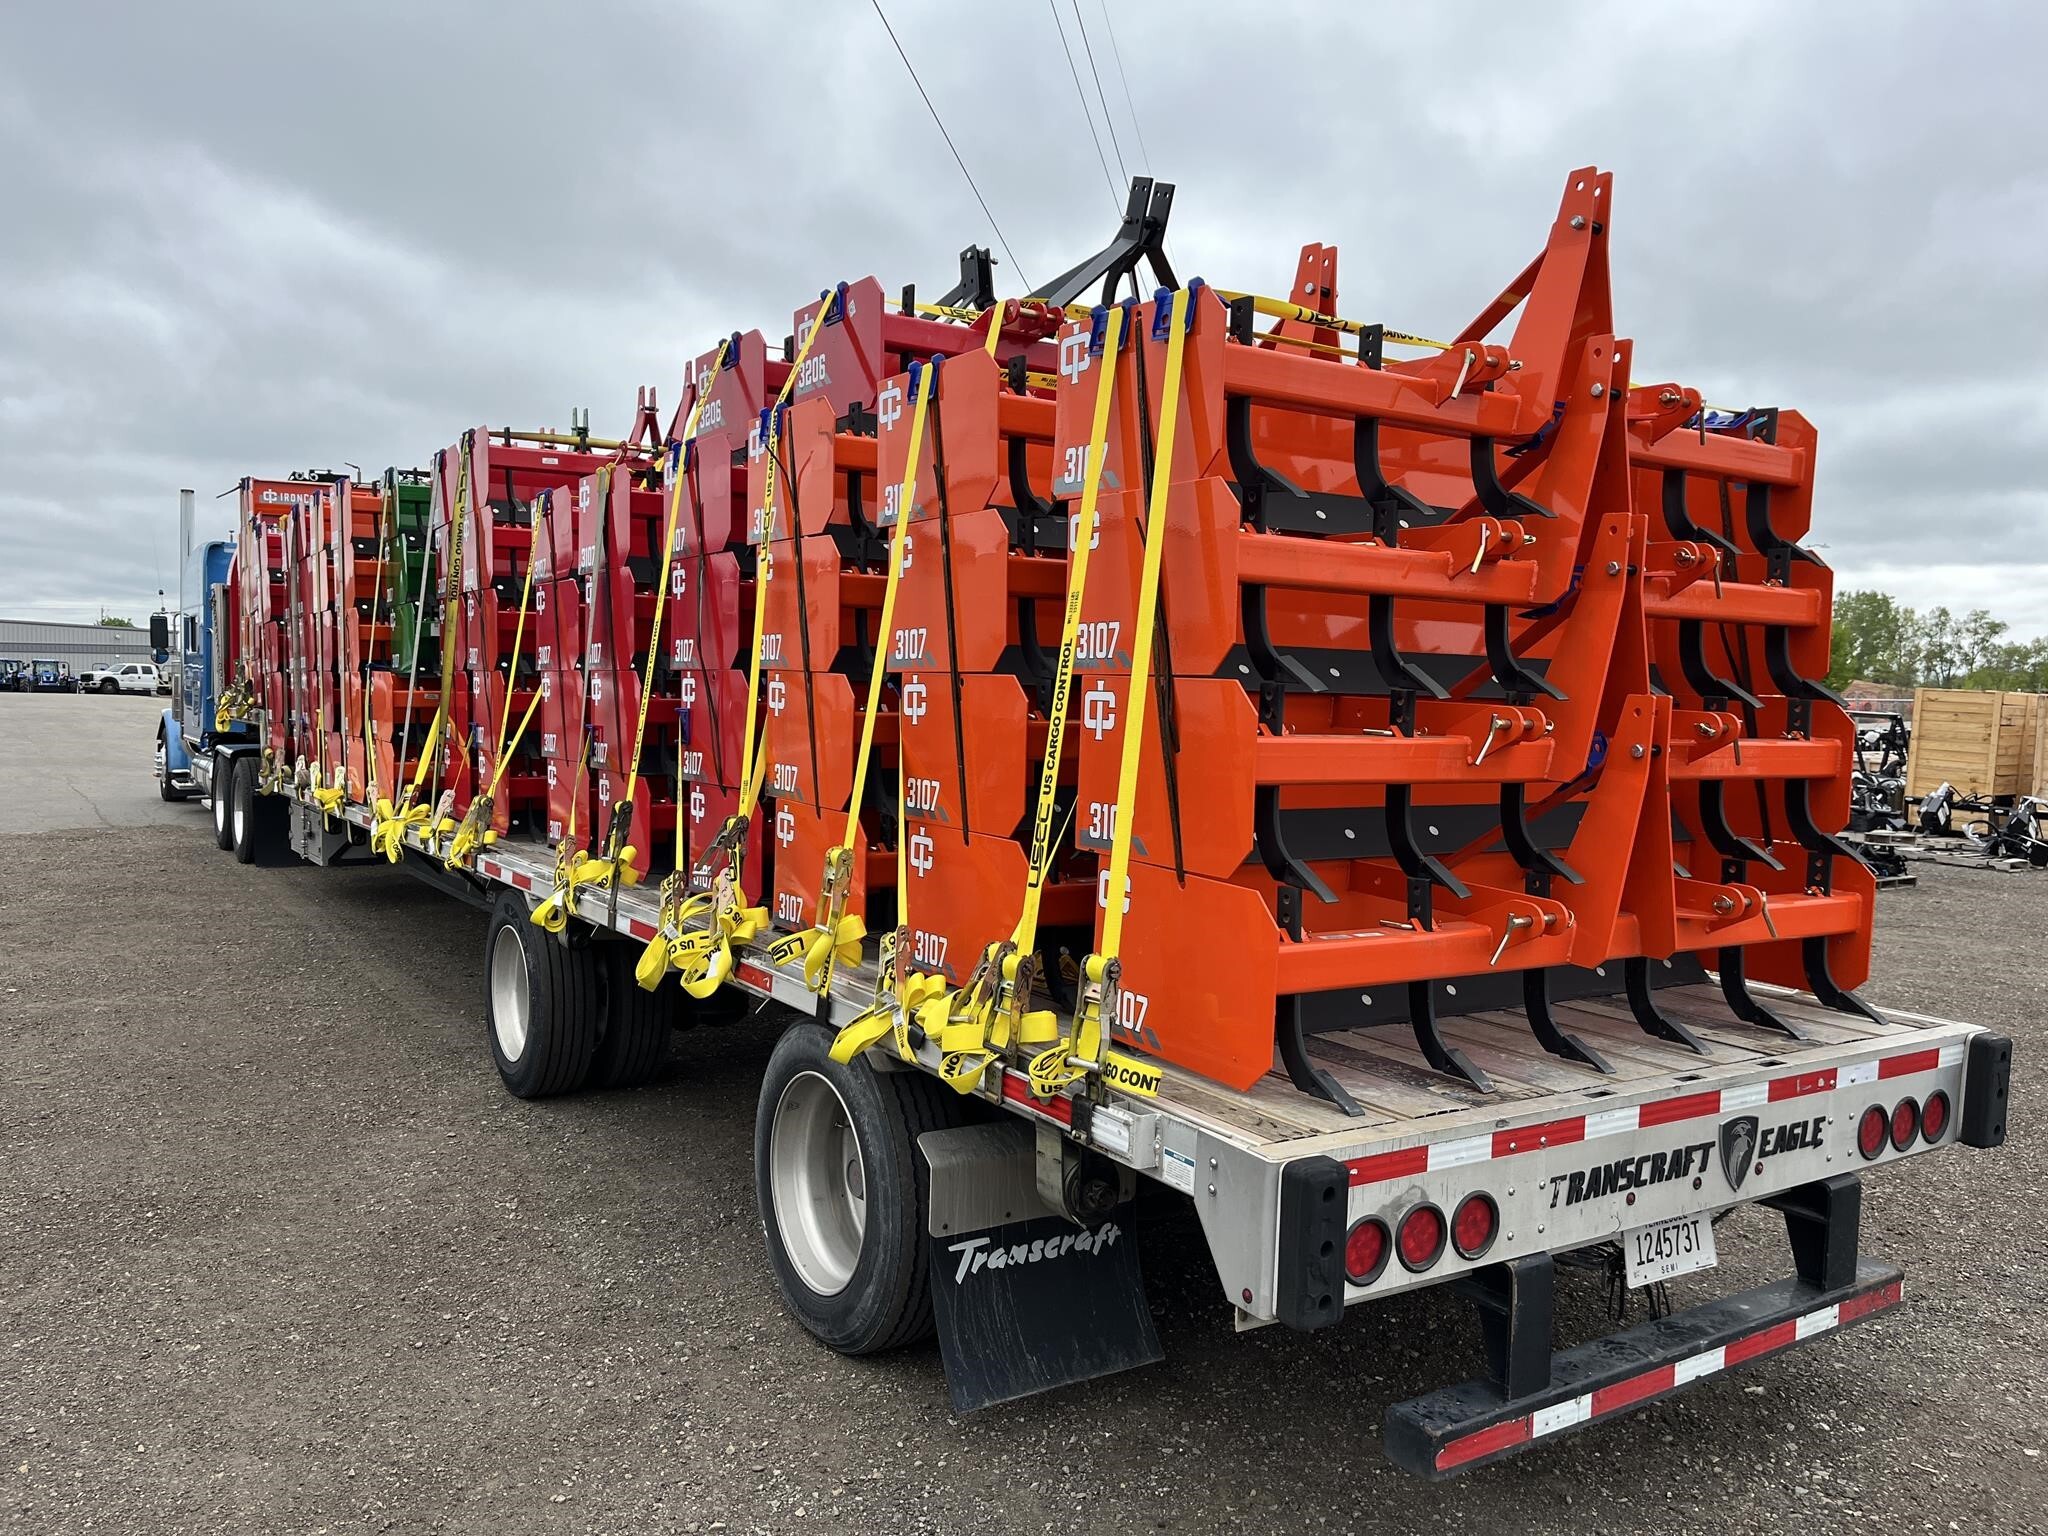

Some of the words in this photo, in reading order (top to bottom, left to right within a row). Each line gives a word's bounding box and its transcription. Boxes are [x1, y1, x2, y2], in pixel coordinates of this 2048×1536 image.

[798, 353, 826, 389] 3206
[700, 399, 722, 429] 3206
[1064, 441, 1108, 484] 317
[884, 480, 917, 516] 317
[590, 642, 602, 664] 107
[675, 639, 694, 662] 3107
[760, 634, 782, 661] 3107
[895, 628, 927, 660] 3107
[1076, 622, 1120, 660] 3107
[1055, 637, 1074, 713] CONTROL
[594, 742, 608, 764] 3107
[1046, 716, 1062, 772] CARGO
[684, 751, 702, 776] 3107
[774, 763, 798, 792] 3107
[906, 777, 940, 812] 3107
[1042, 774, 1053, 796] US
[1089, 802, 1118, 841] 310
[778, 893, 804, 924] 3107
[914, 930, 948, 968] 3107
[1115, 988, 1149, 1034] 107
[1550, 1140, 1716, 1208] TRANSCRAFT
[1758, 1116, 1826, 1159] EAGLE
[948, 1222, 1122, 1285] Transcraft
[1636, 1220, 1700, 1266] 124573T
[1661, 1262, 1678, 1274] SEMI
